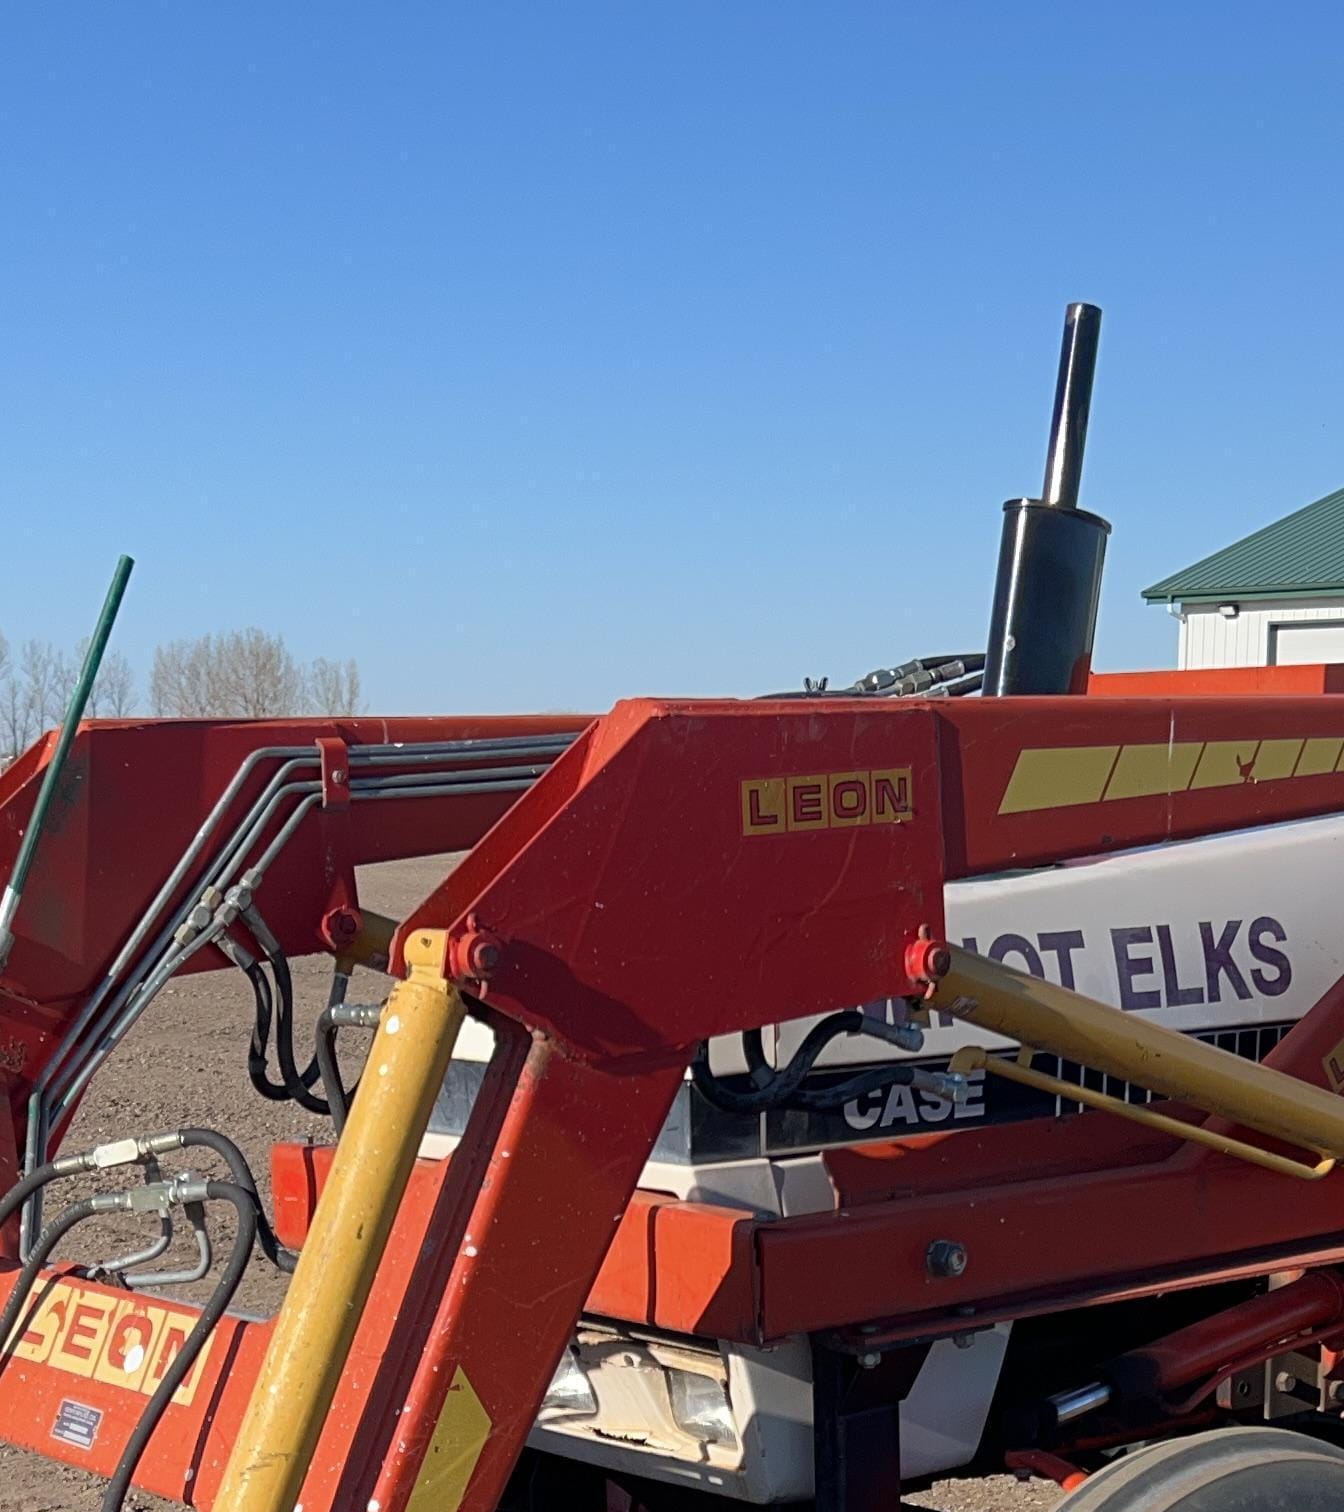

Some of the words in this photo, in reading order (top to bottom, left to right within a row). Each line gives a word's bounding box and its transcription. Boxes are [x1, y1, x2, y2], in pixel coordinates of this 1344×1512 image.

[748, 776, 911, 827] LEON
[1110, 916, 1293, 1011] ELKS
[843, 1068, 987, 1131] CASE
